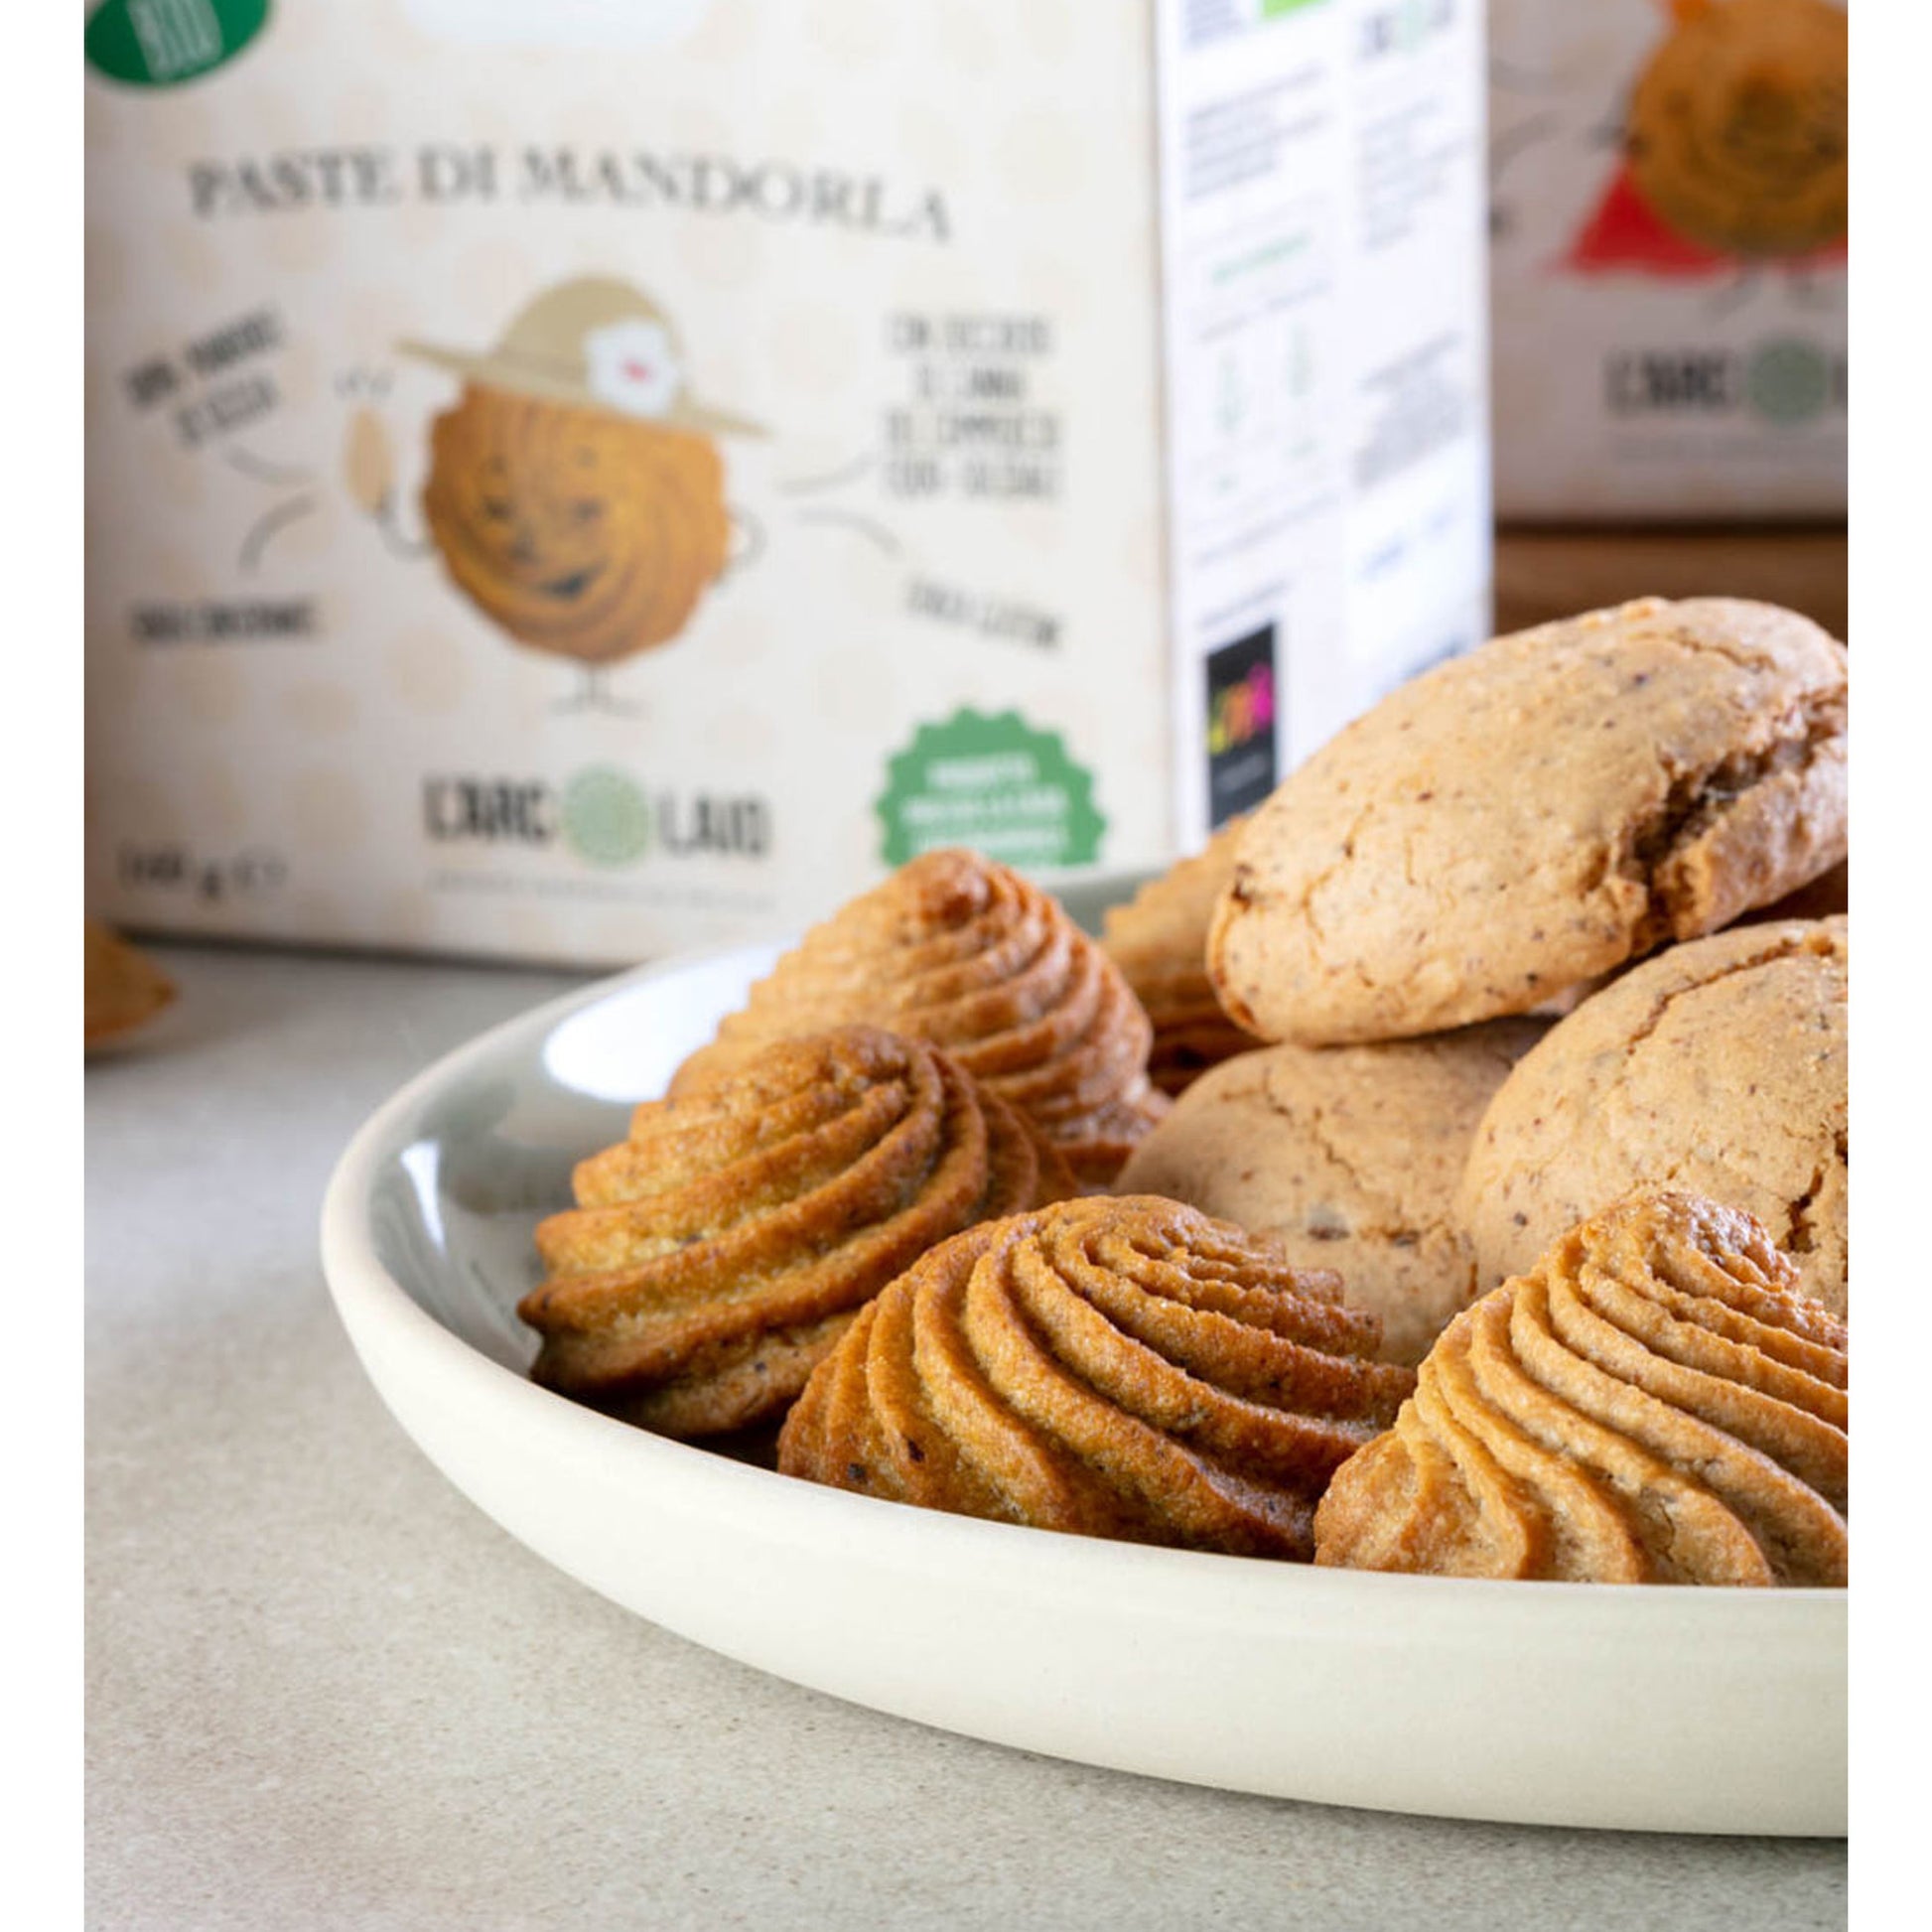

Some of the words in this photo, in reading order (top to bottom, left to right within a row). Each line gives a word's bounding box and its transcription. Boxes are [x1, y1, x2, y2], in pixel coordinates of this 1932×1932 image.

[187, 145, 394, 219] PASTE
[417, 143, 498, 205] DI
[520, 146, 953, 244] MANDORLA
